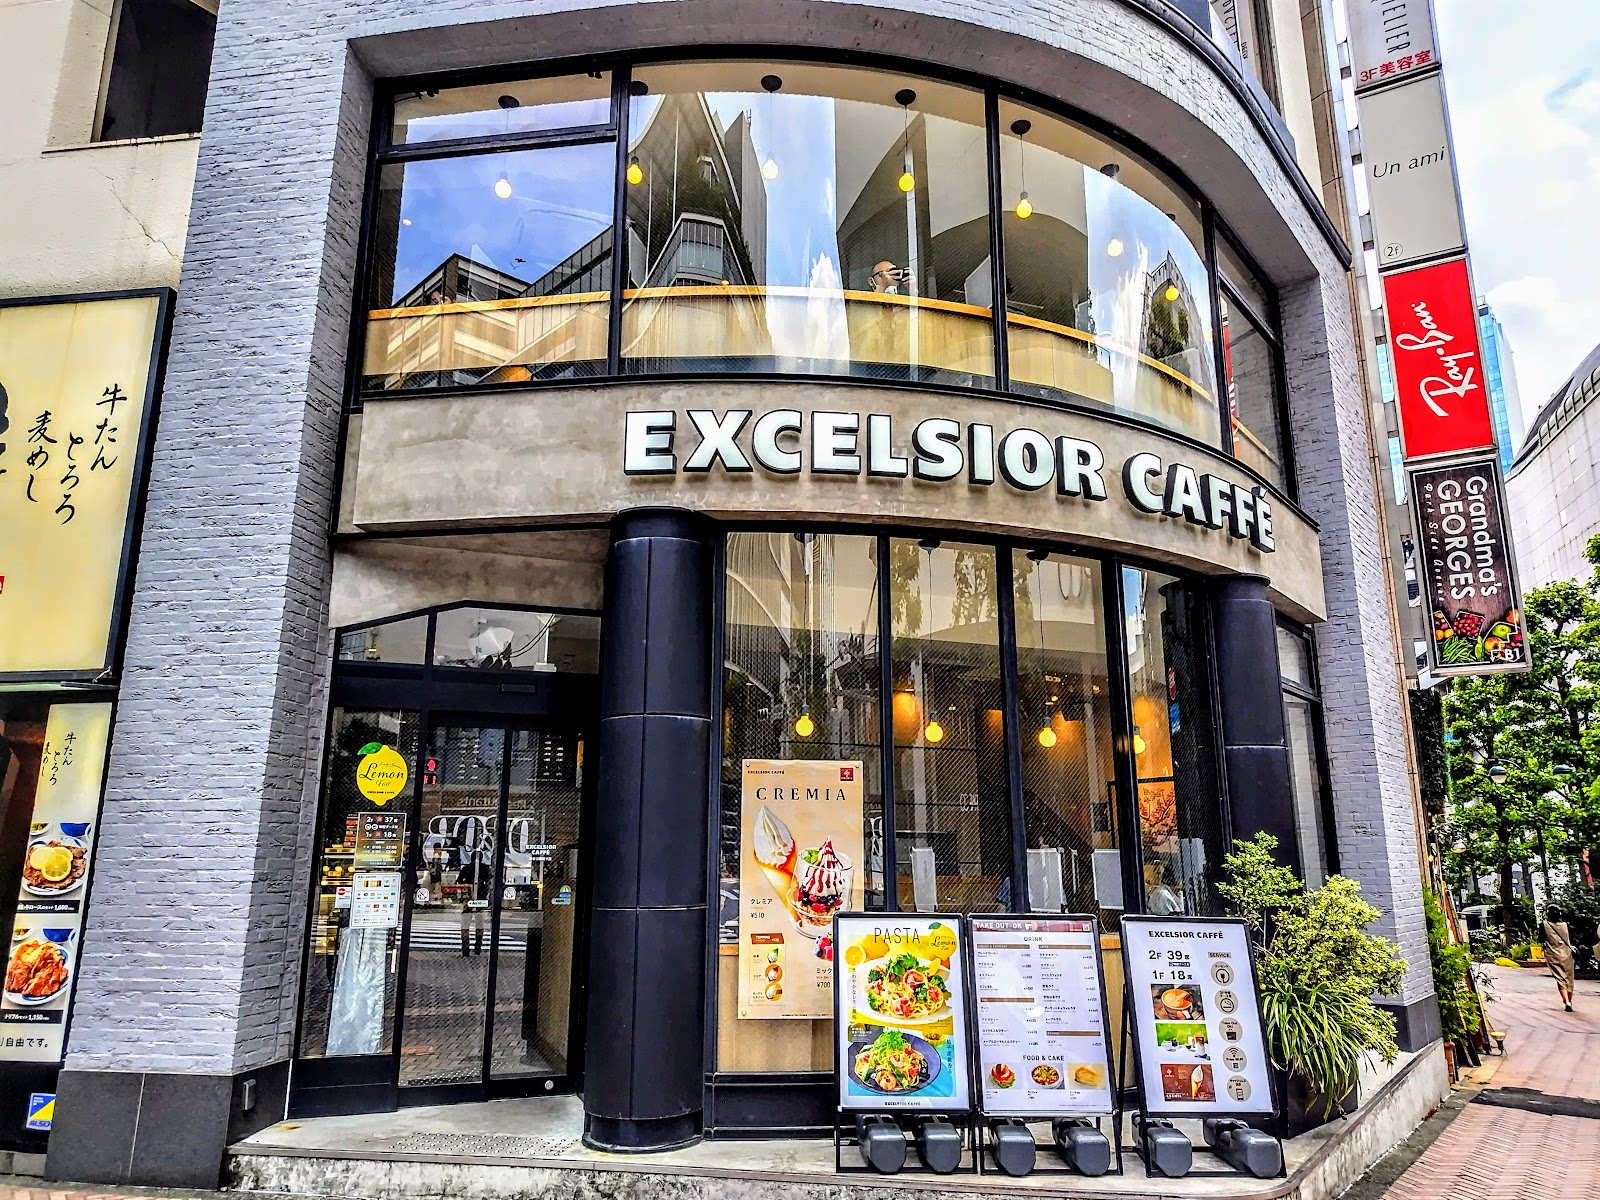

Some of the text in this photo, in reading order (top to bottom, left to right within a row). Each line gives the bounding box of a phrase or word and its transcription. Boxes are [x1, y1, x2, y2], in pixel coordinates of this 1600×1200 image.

[1360, 50, 1433, 82] 3F美容室
[1372, 146, 1446, 178] Un ami
[90, 383, 128, 471] 牛たん
[26, 410, 58, 503] 麦めし
[623, 409, 1109, 503] EXCELSIOR
[54, 431, 84, 526] とろろ
[1423, 483, 1436, 513] Park
[1428, 521, 1440, 550] Side
[1437, 479, 1476, 600] GEORGES
[1465, 475, 1502, 597] Grandma's
[1505, 648, 1520, 660] B1
[62, 732, 77, 766] 牛たん
[359, 762, 404, 781] Lemon
[756, 787, 846, 801] CREMIA
[874, 927, 921, 944] PASTA
[1148, 930, 1195, 939] EXCELSIOR
